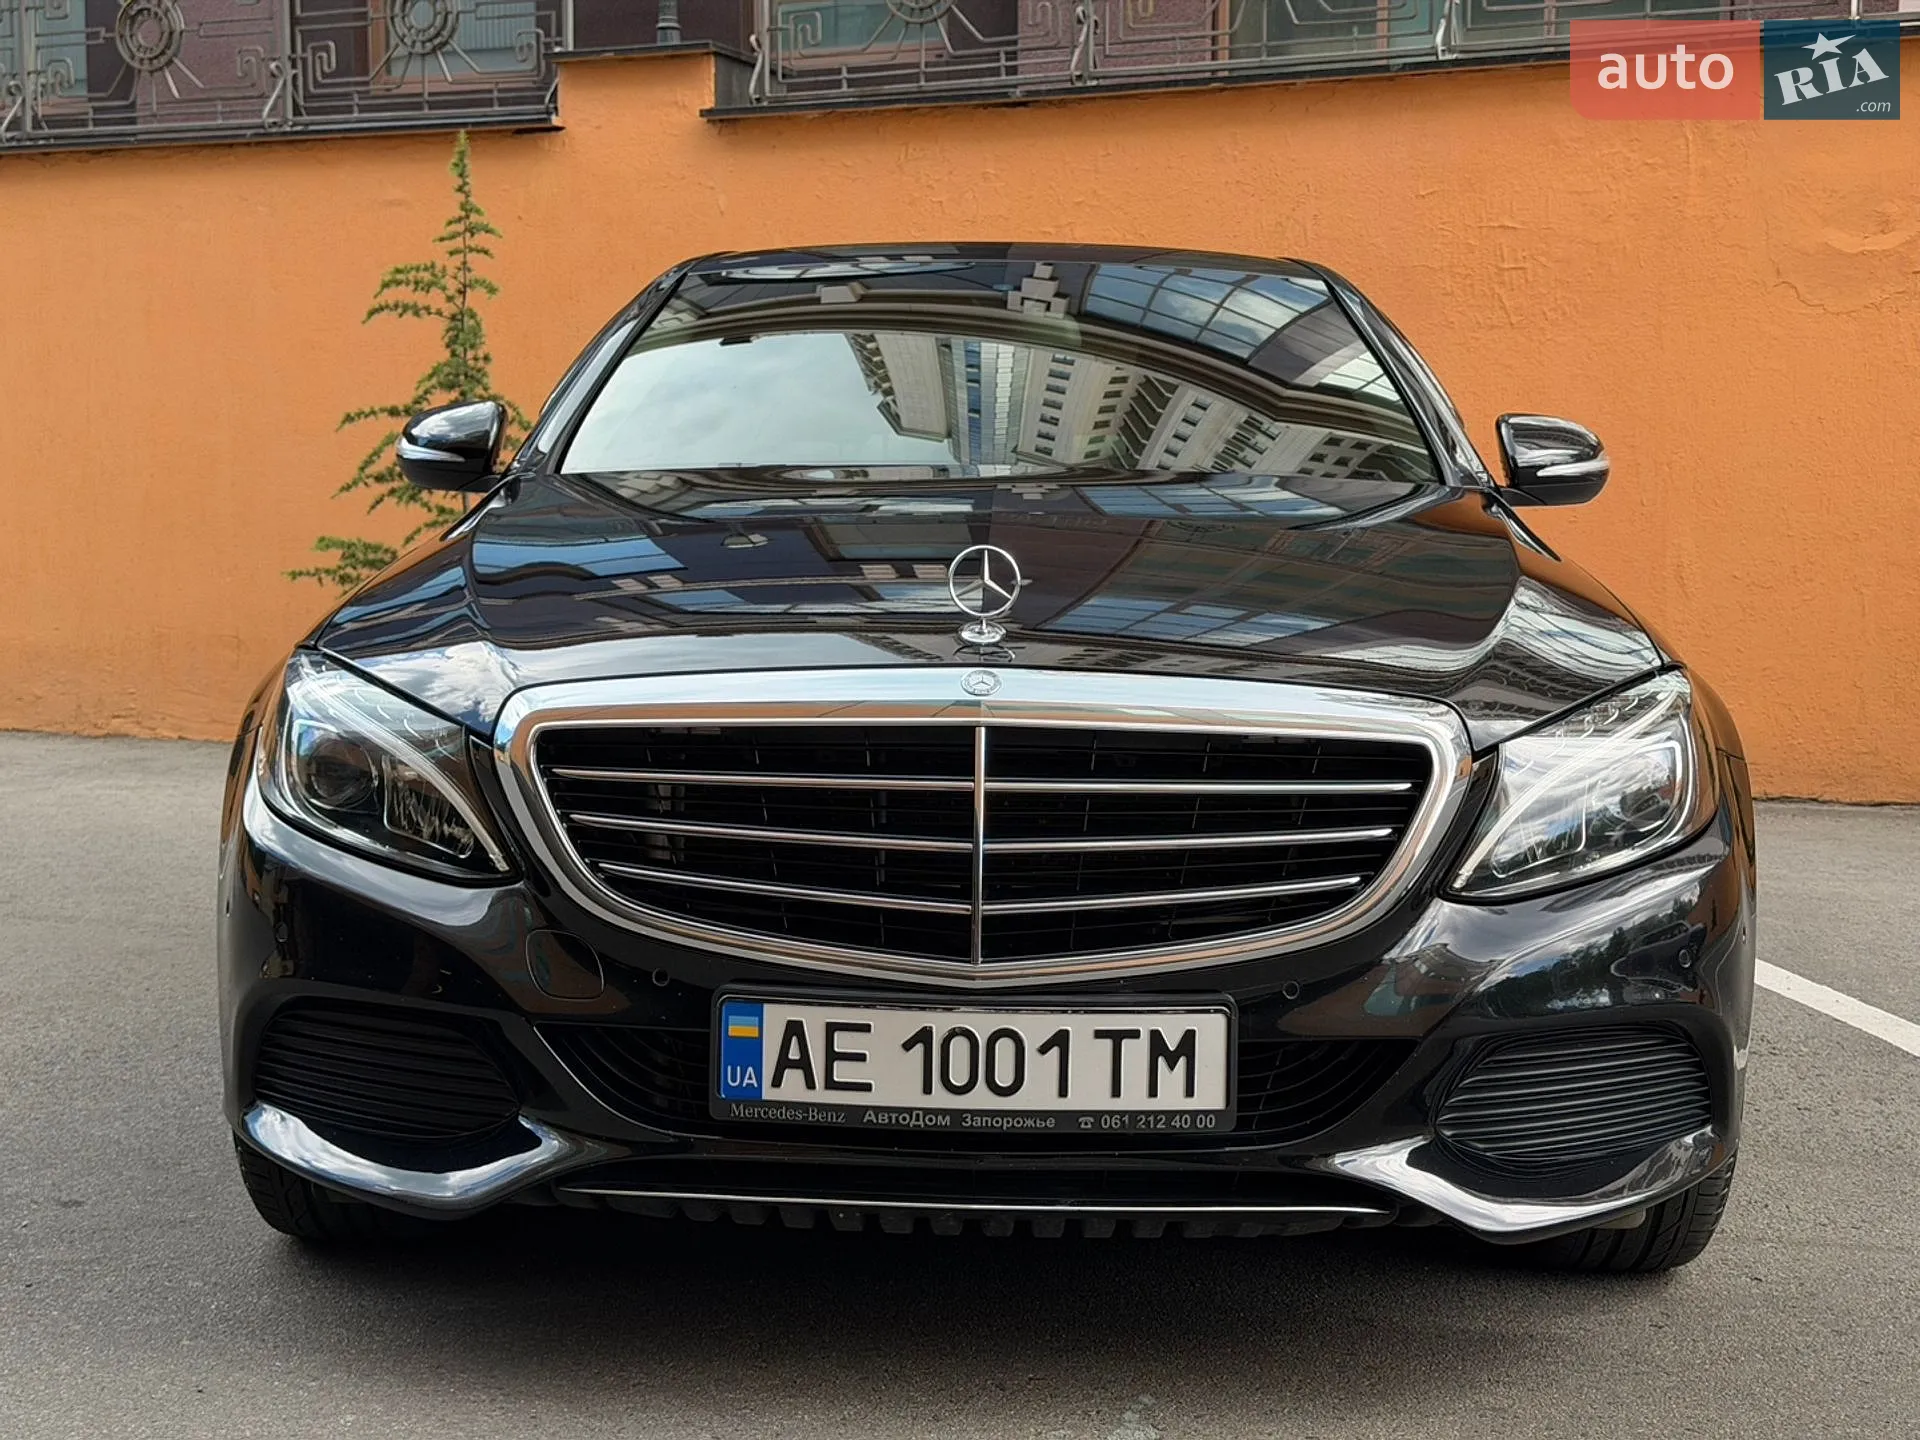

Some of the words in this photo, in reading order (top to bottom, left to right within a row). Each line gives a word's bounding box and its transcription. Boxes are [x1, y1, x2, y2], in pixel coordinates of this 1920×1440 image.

[771, 1019, 874, 1091] AE
[901, 1025, 1072, 1098] 1001
[1094, 1027, 1197, 1098] TM
[727, 1065, 758, 1088] UA
[730, 1103, 846, 1123] Mercedes-Benz
[863, 1110, 951, 1128] АвтоДом
[961, 1113, 1056, 1130] Запорожье
[1101, 1115, 1130, 1129] 061
[1136, 1115, 1166, 1129] 212
[1171, 1115, 1191, 1129] 40
[1196, 1114, 1216, 1129] 00
